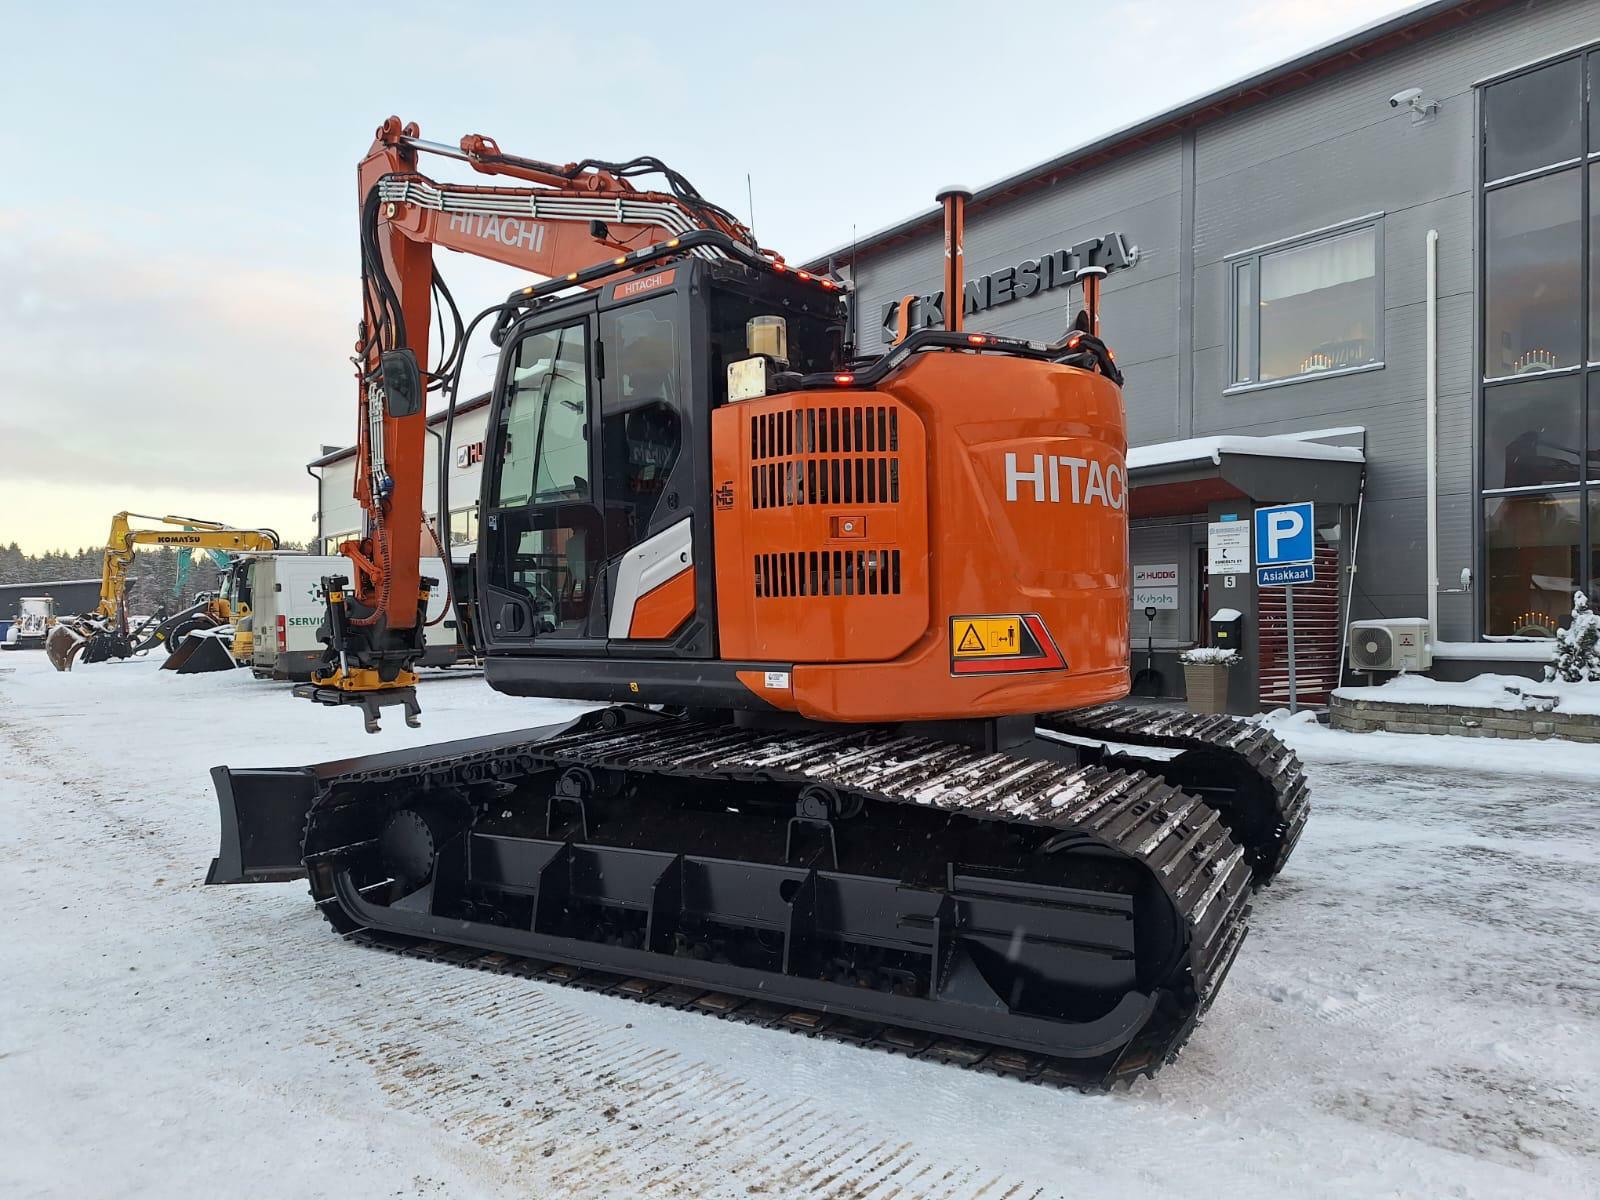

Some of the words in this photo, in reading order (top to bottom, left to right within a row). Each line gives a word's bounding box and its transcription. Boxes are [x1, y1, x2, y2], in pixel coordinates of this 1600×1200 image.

[449, 213, 545, 253] HITACHI
[625, 274, 663, 295] HITACHI
[920, 231, 1131, 328] KNESILTA
[157, 535, 201, 543] KOMATSU
[1267, 510, 1304, 559] P
[1146, 571, 1176, 579] HUDDIG
[1227, 576, 1233, 587] 5
[1263, 568, 1310, 582] Asiakkaat
[1137, 594, 1173, 603] Kubota
